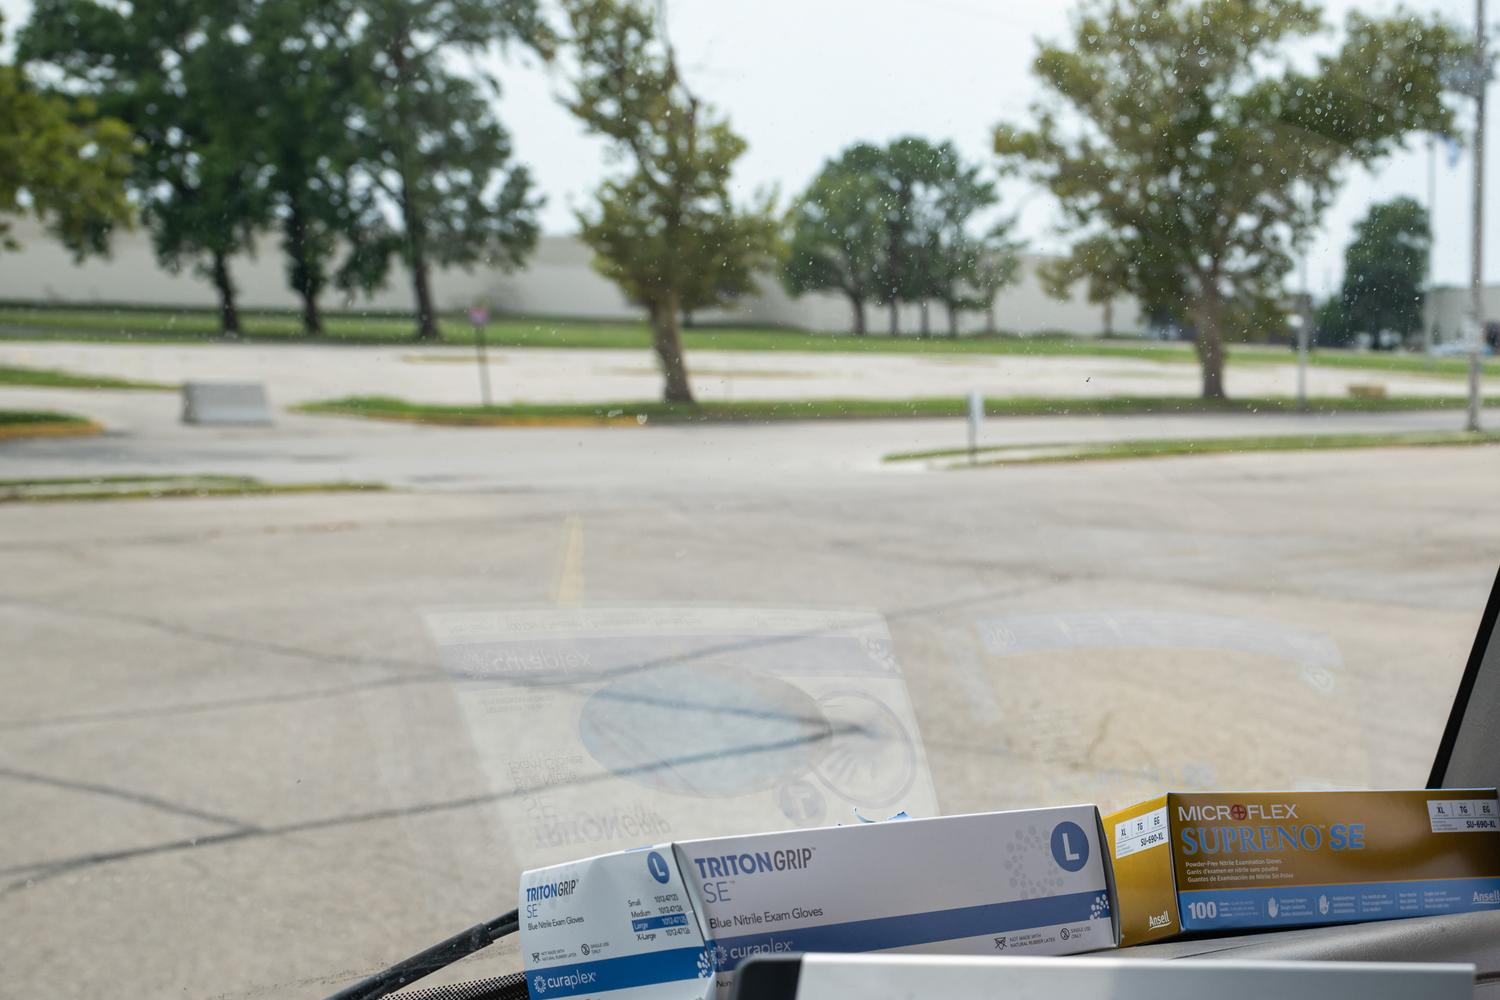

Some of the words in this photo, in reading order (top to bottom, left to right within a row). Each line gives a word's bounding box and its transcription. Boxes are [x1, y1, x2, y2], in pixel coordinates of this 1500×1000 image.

[1178, 803, 1298, 822] MICROFLEX
[1329, 823, 1366, 850] SE
[1062, 832, 1079, 861] L
[652, 857, 666, 877] L
[703, 881, 732, 904] SE
[1471, 889, 1500, 903] Ansell
[527, 902, 539, 918] SE
[710, 918, 732, 929] Blue
[733, 914, 762, 926] Nitrile
[764, 911, 790, 922] Exam
[792, 907, 823, 920] Gloves
[1149, 910, 1169, 927] Ansell
[1188, 901, 1217, 919] 100
[528, 923, 538, 931] Blue
[538, 920, 552, 929] Nitrile
[552, 918, 566, 927] Exam
[566, 916, 584, 925] Gloves
[548, 969, 596, 990] curaplex
